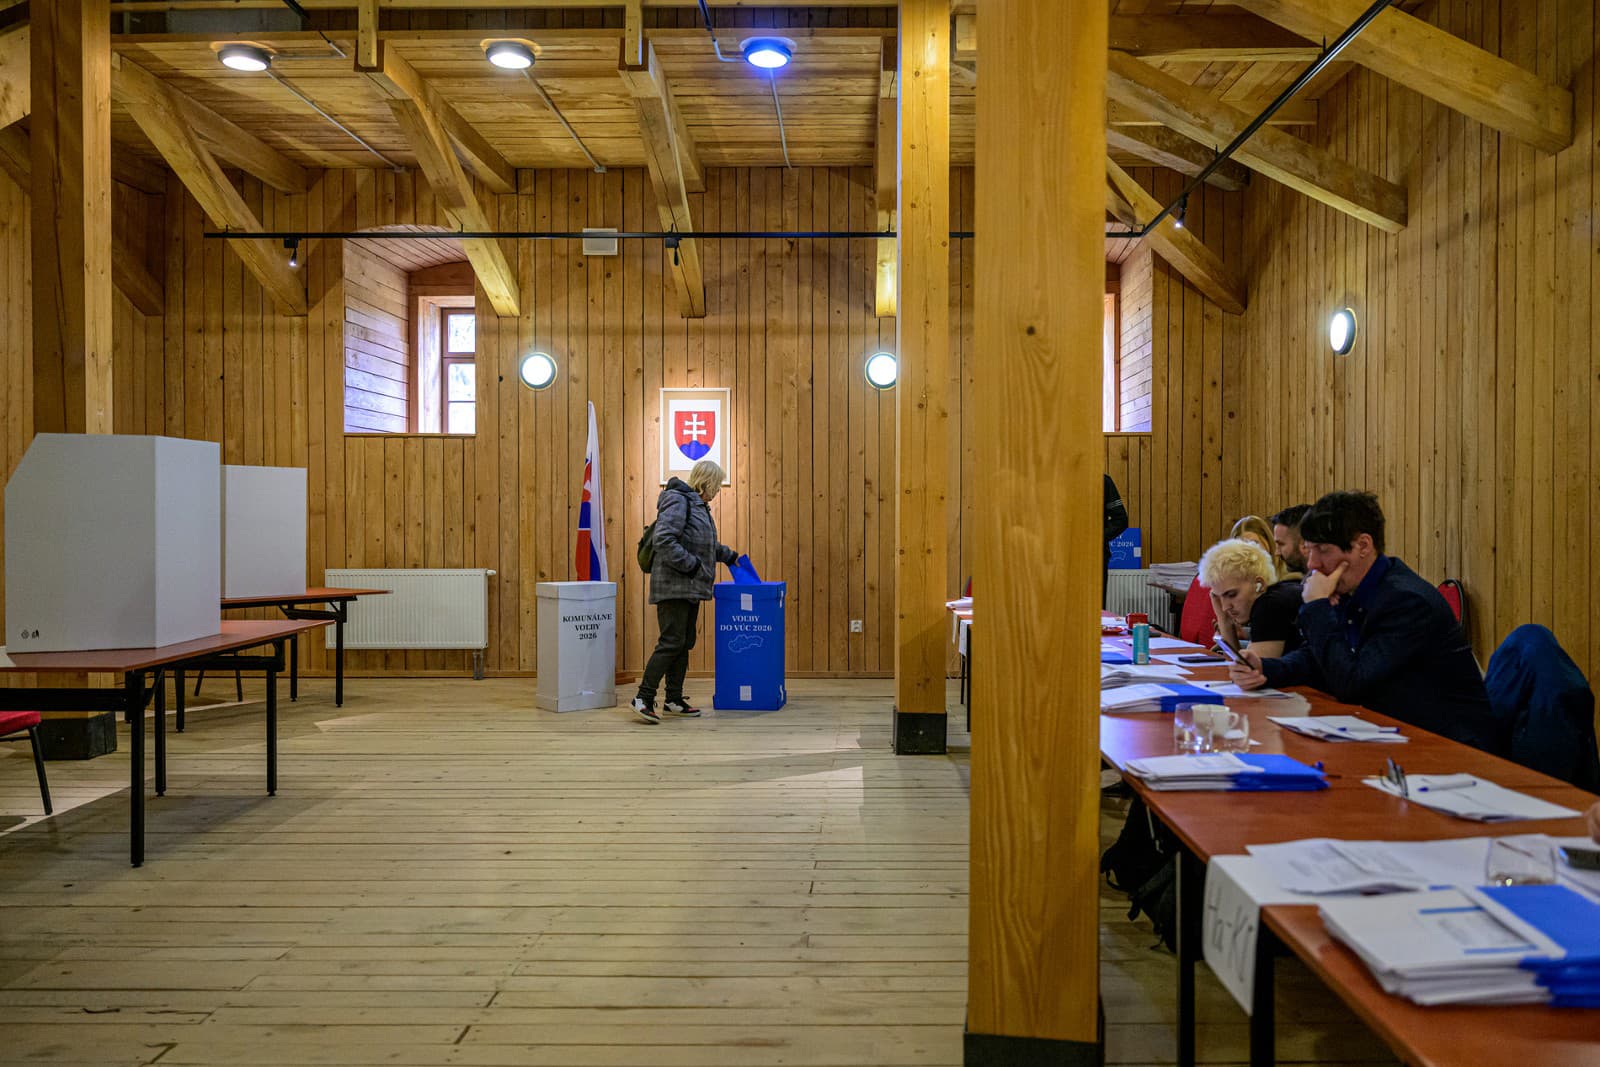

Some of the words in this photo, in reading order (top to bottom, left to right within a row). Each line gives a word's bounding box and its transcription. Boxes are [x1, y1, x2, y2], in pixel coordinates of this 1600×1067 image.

[562, 613, 612, 623] KOMUNÁLNE
[734, 622, 751, 631] VÚC
[752, 624, 773, 632] 2026
[578, 632, 597, 640] 2026
